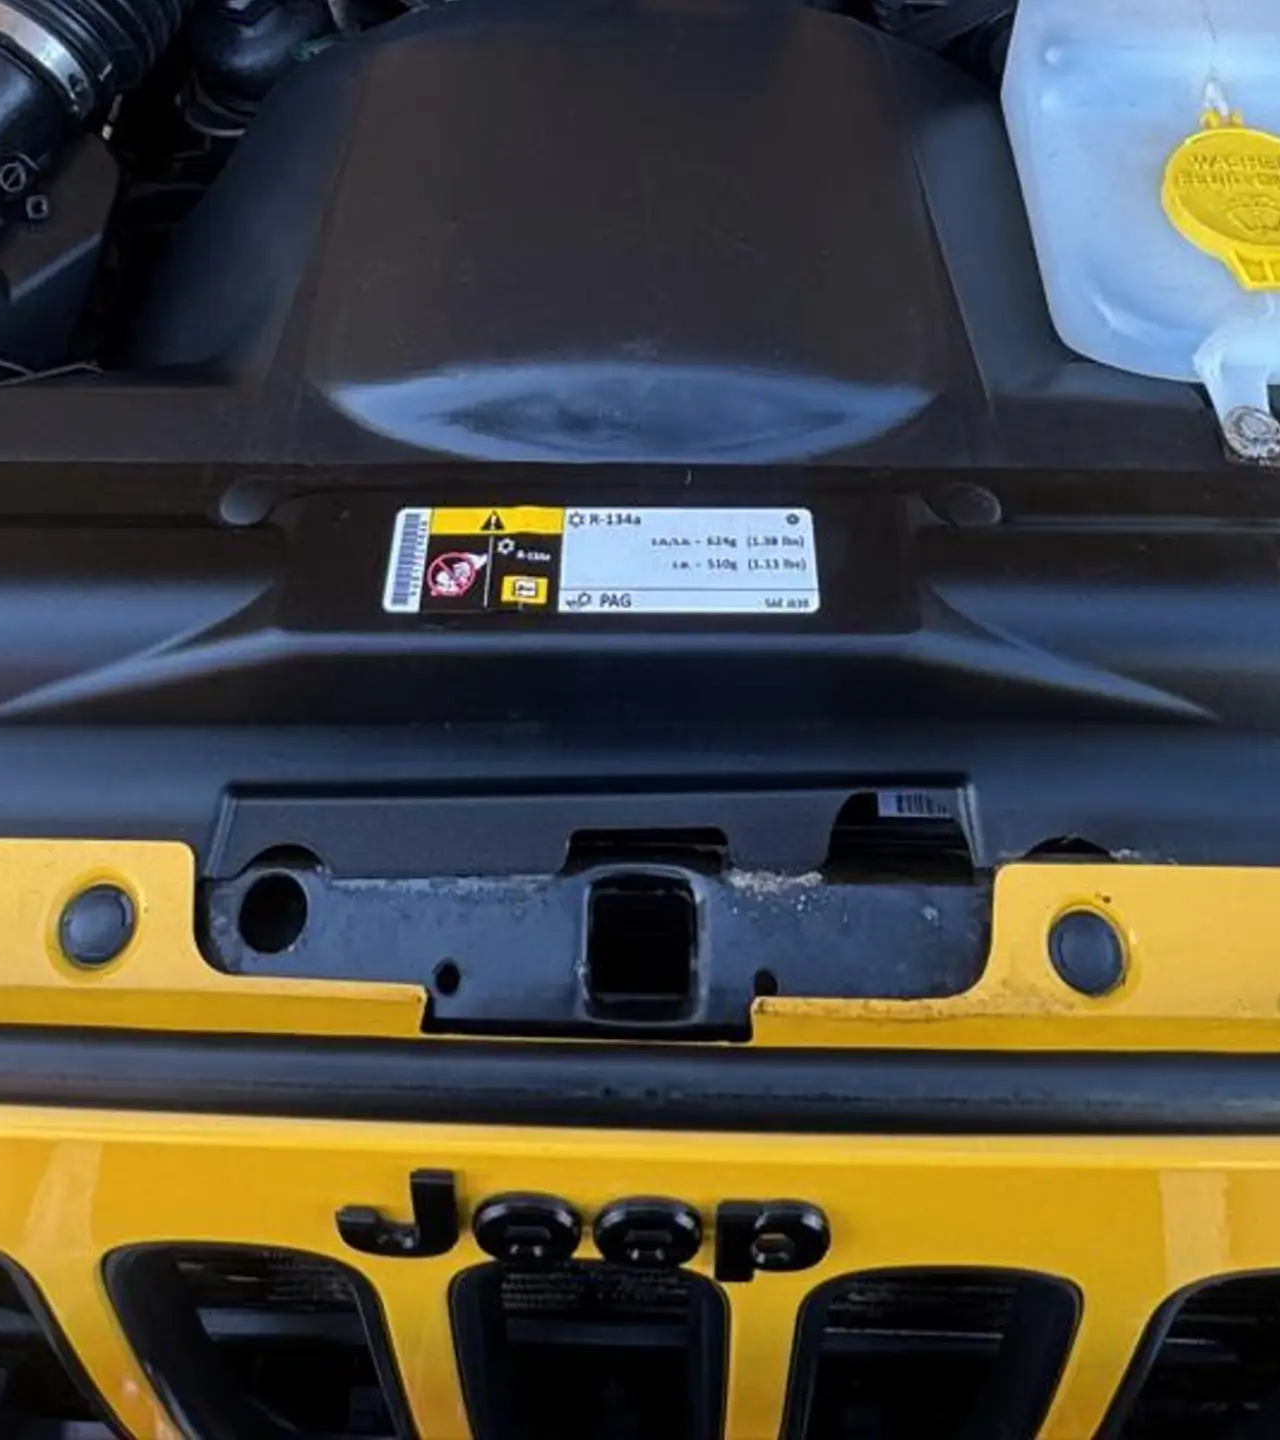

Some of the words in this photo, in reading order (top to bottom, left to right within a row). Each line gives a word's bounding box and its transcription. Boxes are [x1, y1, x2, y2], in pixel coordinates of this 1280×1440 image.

[588, 513, 642, 527] R-134a
[599, 593, 632, 608] PAG
[334, 1167, 832, 1283] Jeep
